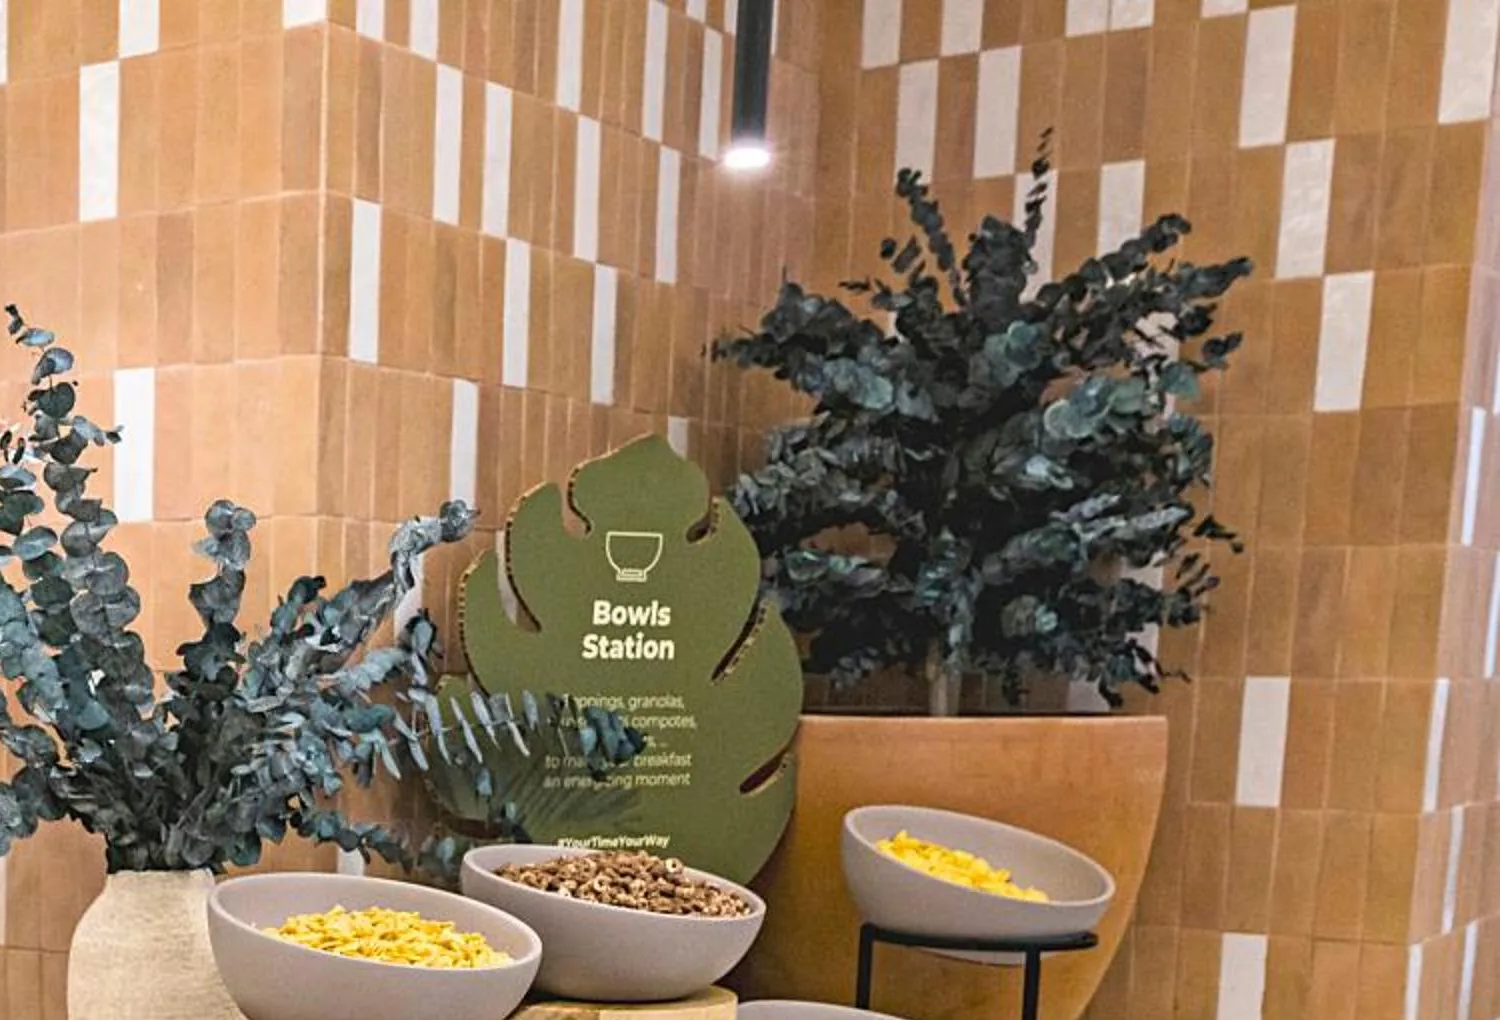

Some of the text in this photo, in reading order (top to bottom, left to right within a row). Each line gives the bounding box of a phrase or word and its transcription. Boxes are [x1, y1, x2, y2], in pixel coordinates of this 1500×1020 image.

[592, 600, 671, 626] Bowls
[582, 632, 675, 660] Station
[635, 772, 691, 786] moment
[557, 833, 671, 849] #YourTimeYourWay
